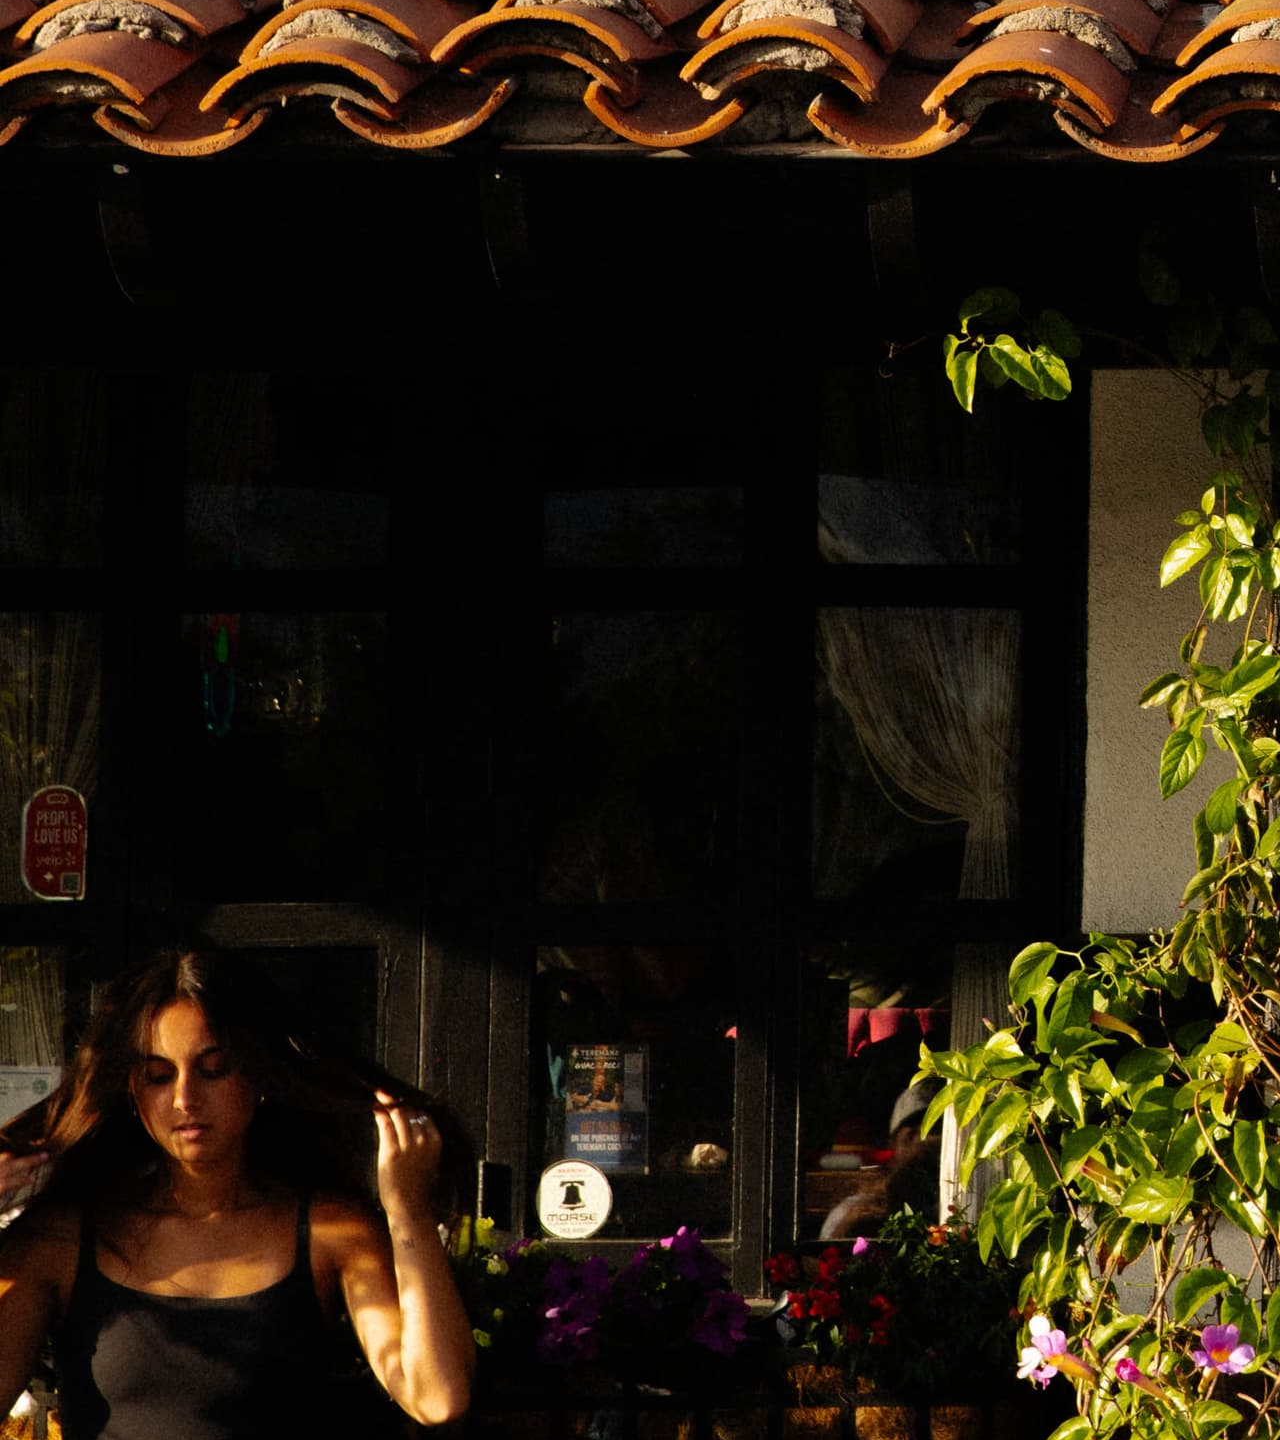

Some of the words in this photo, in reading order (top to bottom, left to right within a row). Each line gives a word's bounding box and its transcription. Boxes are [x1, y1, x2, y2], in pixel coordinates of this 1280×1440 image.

[36, 809, 78, 826] PEOPLE
[33, 827, 61, 844] LOVE
[63, 827, 79, 844] US
